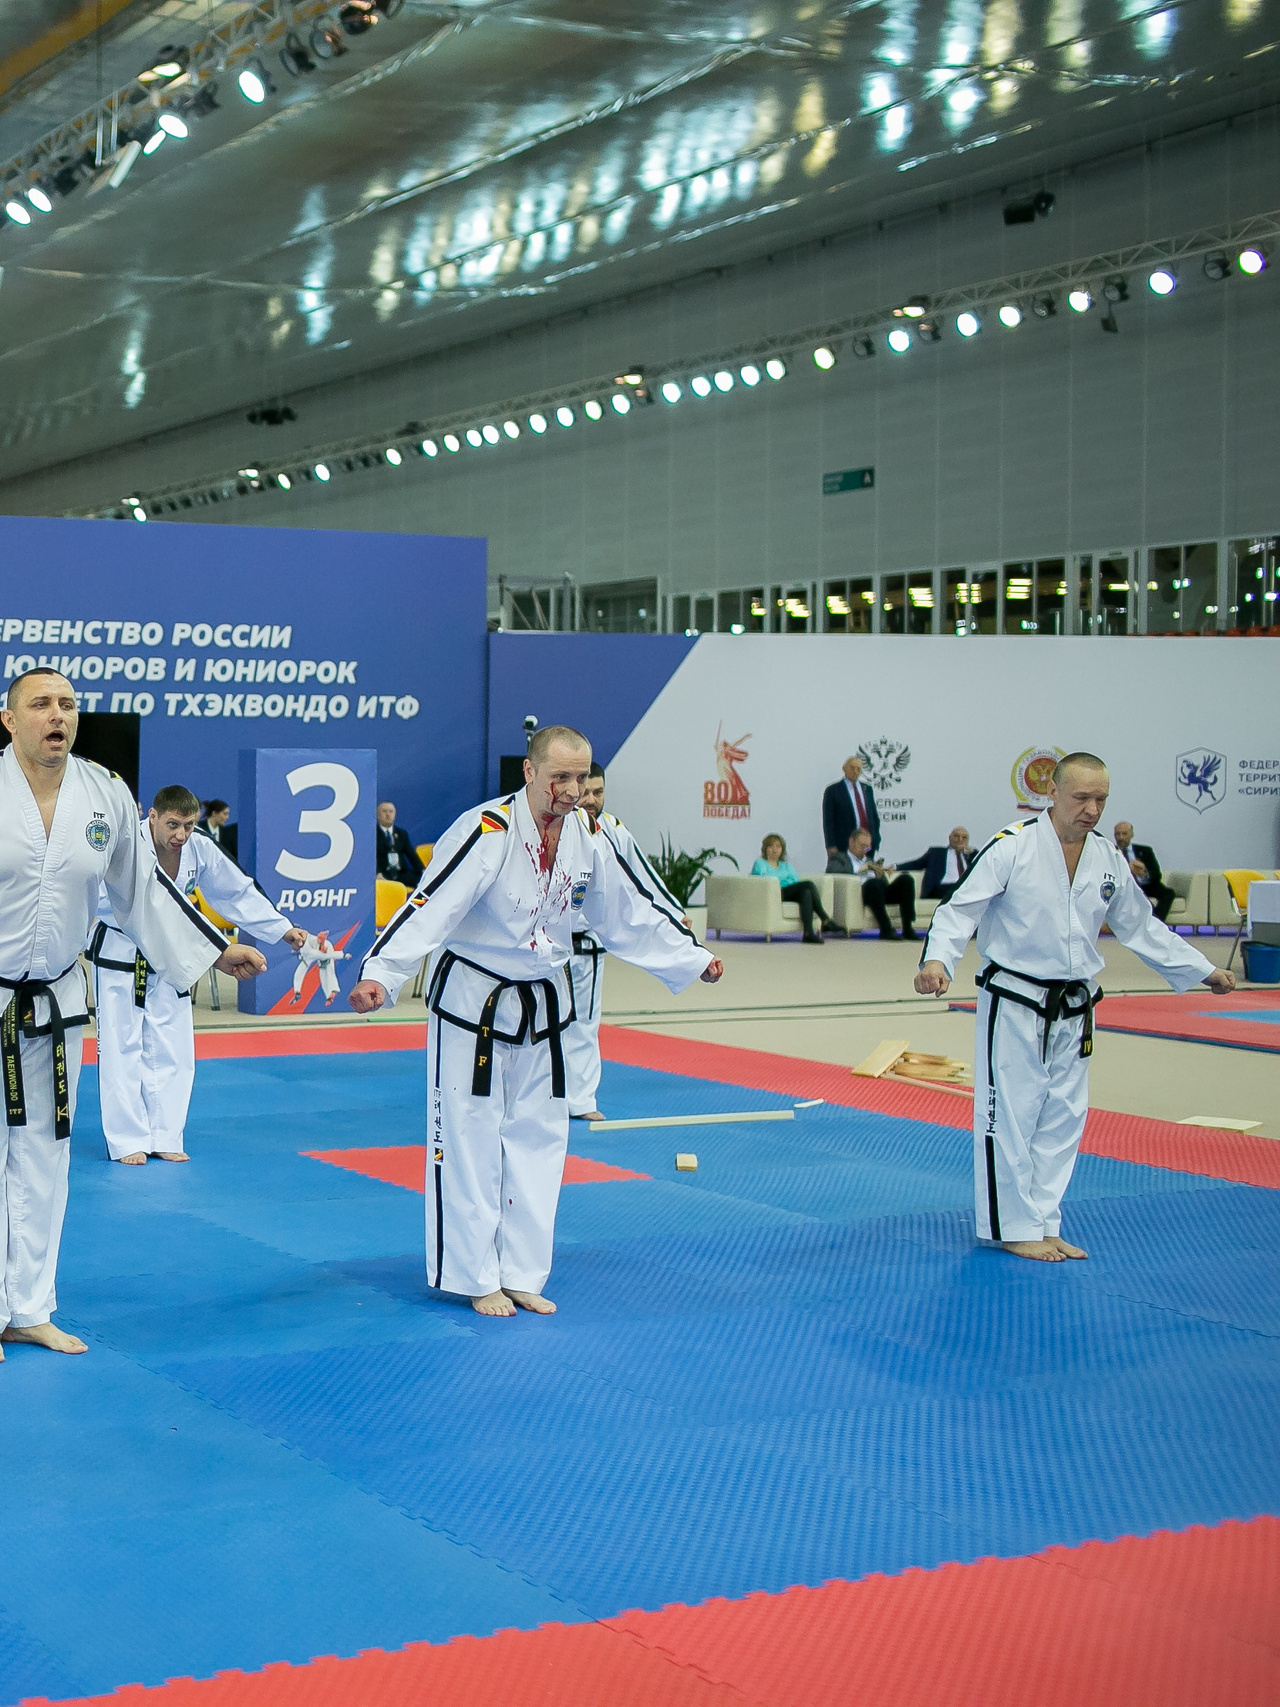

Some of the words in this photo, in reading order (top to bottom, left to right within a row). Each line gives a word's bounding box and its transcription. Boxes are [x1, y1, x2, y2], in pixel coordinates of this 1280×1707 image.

[171, 622, 293, 649] РОССИИ
[173, 657, 197, 682] И
[203, 658, 358, 685] ЮНИОРОК
[109, 692, 155, 717] ПО
[164, 693, 350, 723] ТХЭКВОНДО
[356, 694, 420, 720] ИТФ
[1238, 759, 1280, 769] ФЕДЕР
[1238, 773, 1280, 782] ТЕРРИТ
[703, 781, 729, 803] 80
[1238, 786, 1280, 795] «СИРИ
[876, 798, 914, 808] СПОРТ
[275, 762, 360, 883] 3
[277, 888, 359, 912] ДОЯНГ
[9, 1108, 23, 1116] ITF
